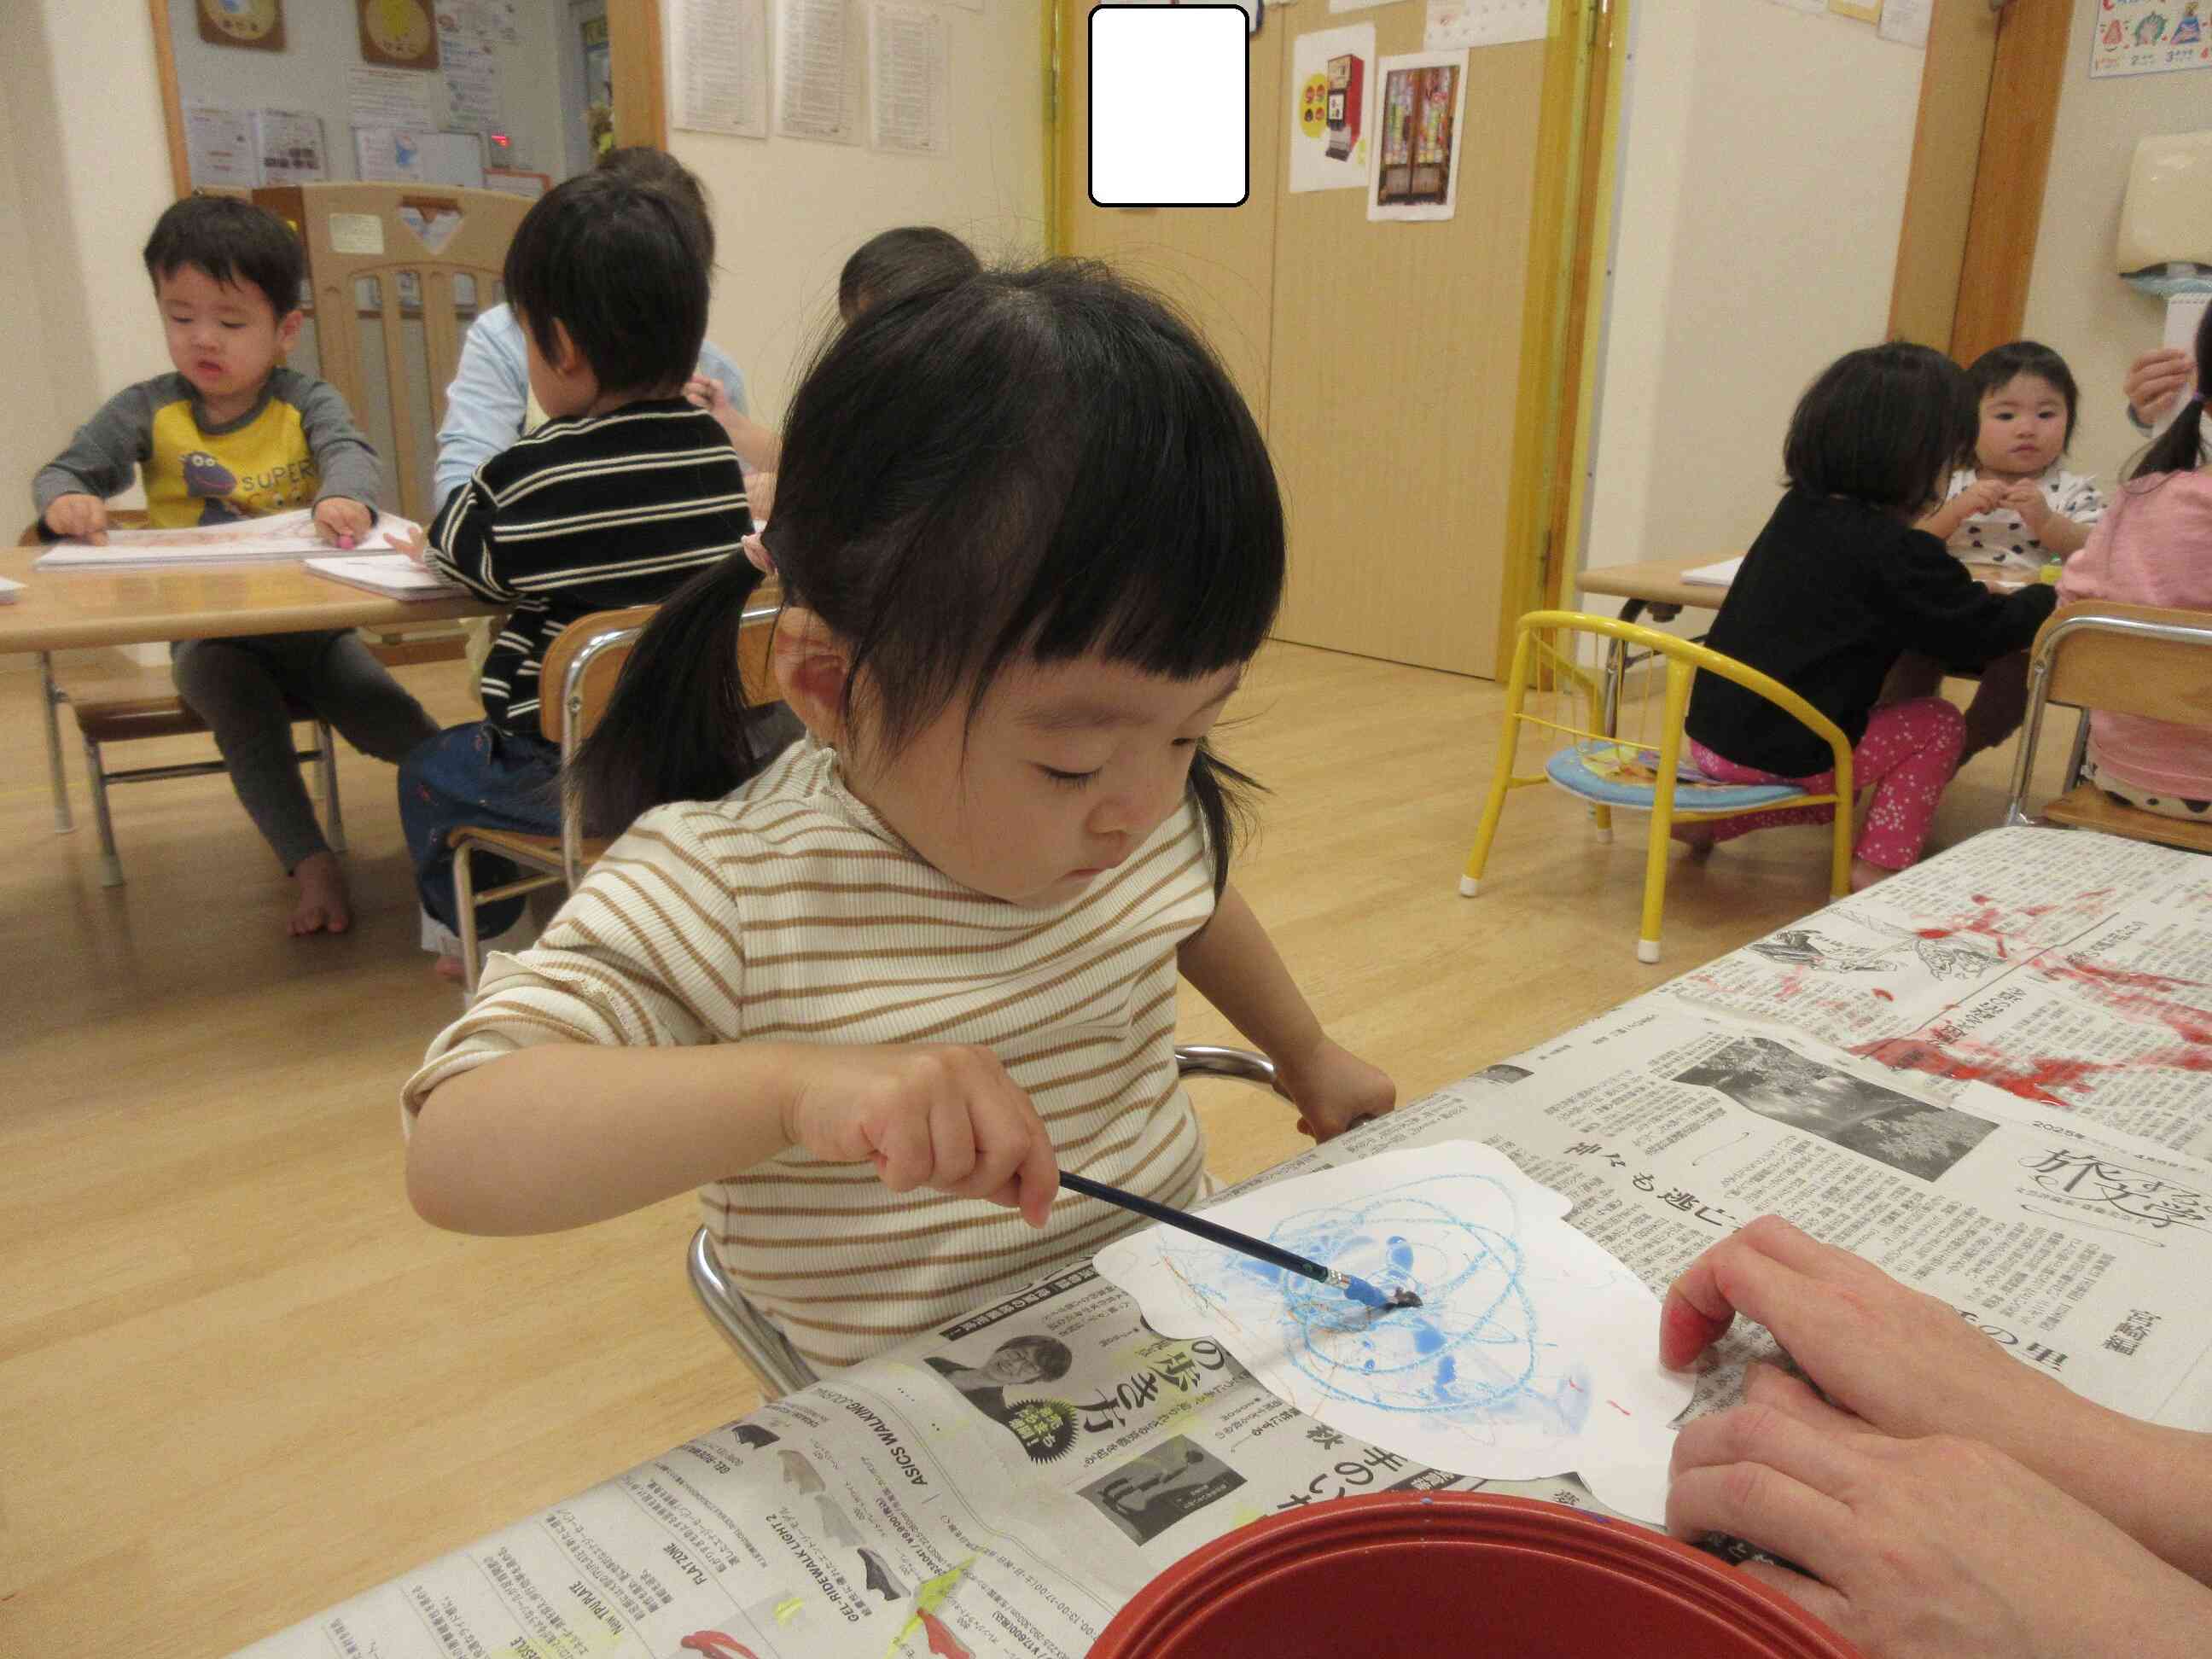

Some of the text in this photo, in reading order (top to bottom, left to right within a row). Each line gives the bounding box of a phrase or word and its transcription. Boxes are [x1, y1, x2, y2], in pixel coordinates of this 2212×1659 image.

[242, 459, 316, 492] SUPER
[1077, 1338, 1227, 1435] の歩き方
[847, 1401, 899, 1446] WALKING
[891, 1447, 928, 1487] ASICS
[765, 1512, 778, 1522] 2
[771, 1522, 800, 1551] LIGHT
[663, 1542, 708, 1586] FLAT ZONE
[568, 1580, 594, 1606] PLATE
[794, 1549, 859, 1621] GEL-RIDEWALK
